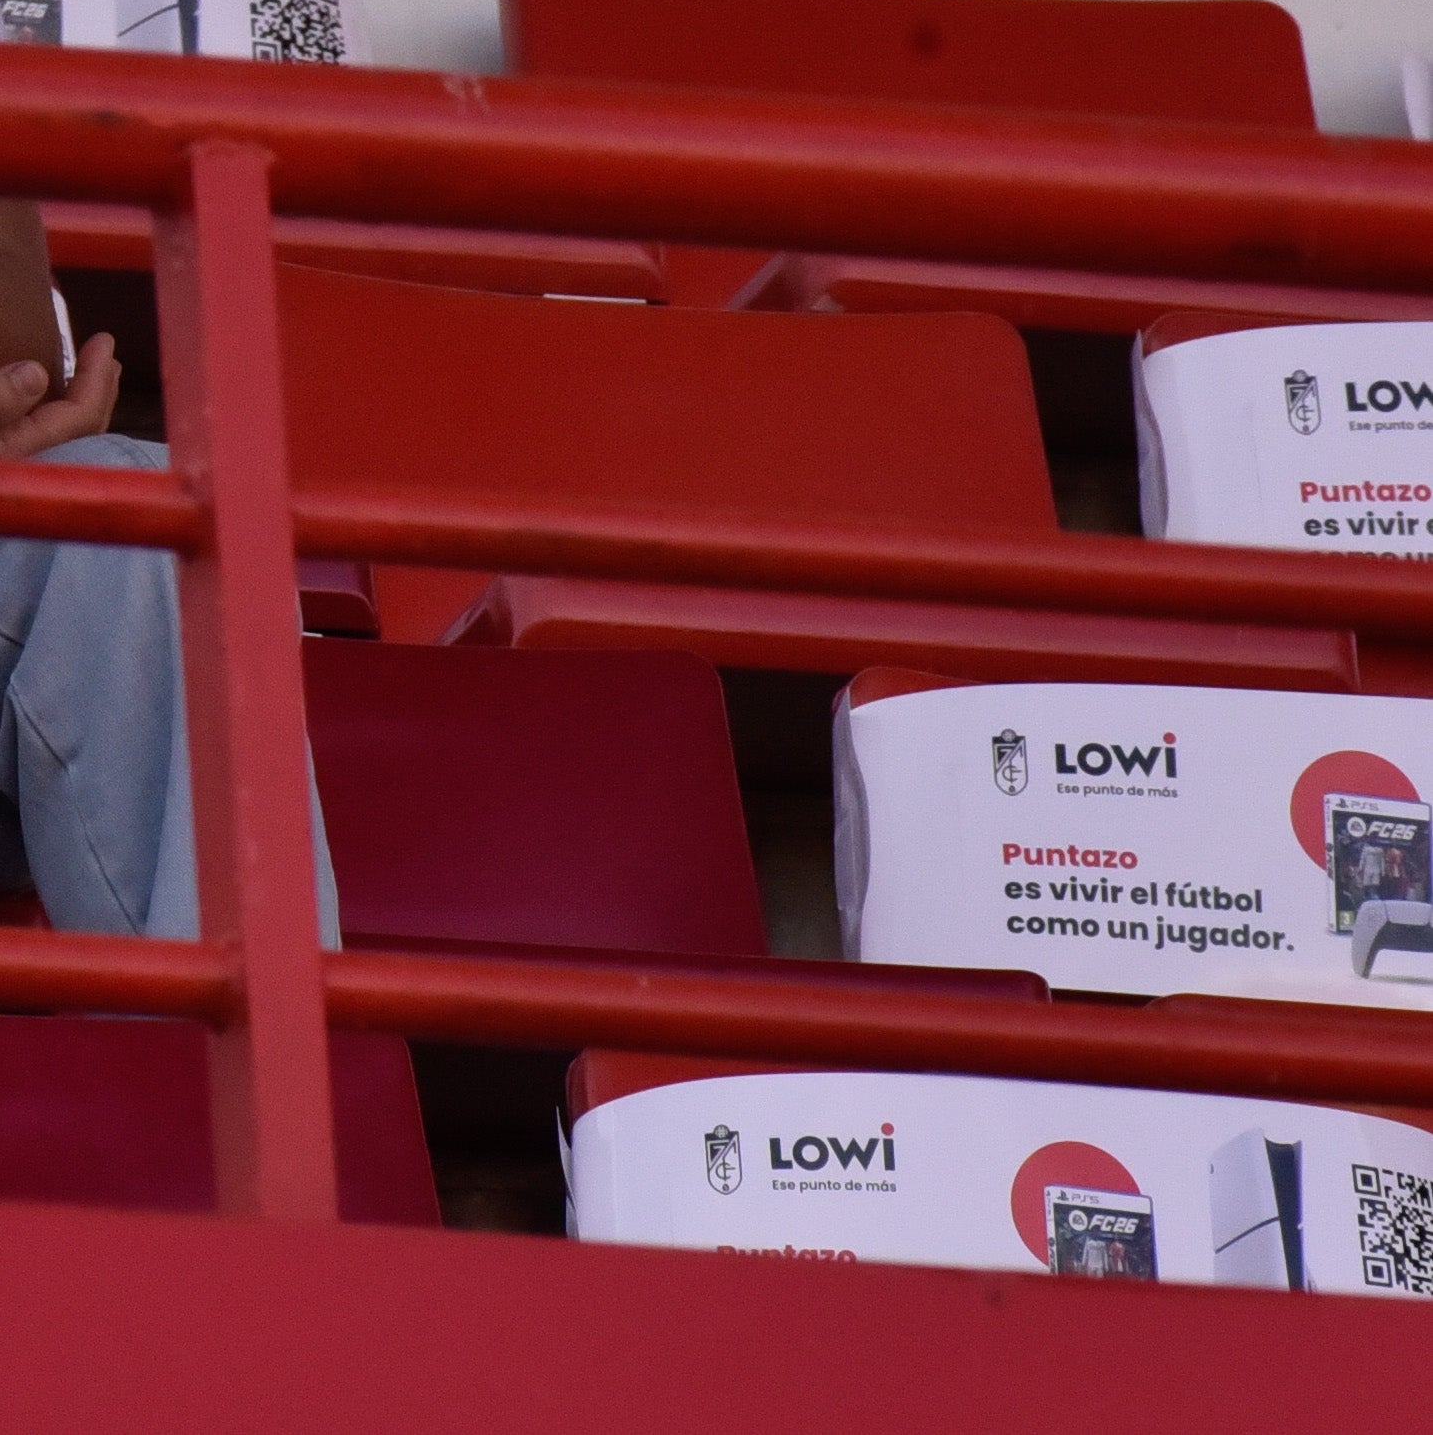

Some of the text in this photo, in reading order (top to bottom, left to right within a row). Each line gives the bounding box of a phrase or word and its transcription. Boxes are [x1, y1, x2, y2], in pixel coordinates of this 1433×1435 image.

[1345, 380, 1433, 413] LOW
[1349, 421, 1372, 431] Ese
[1375, 421, 1415, 433] punto
[1300, 480, 1432, 503] Puntazo
[1304, 519, 1340, 536] es
[1346, 511, 1419, 536] vivir
[1057, 783, 1179, 798] Ese punto de más
[1002, 843, 1139, 869] Puntazo
[1004, 876, 1263, 913] es vivir el fútbol
[1006, 915, 1295, 953] como un jugador.
[772, 1179, 897, 1193] Ese punto de más
[1089, 1213, 1139, 1234] FC26
